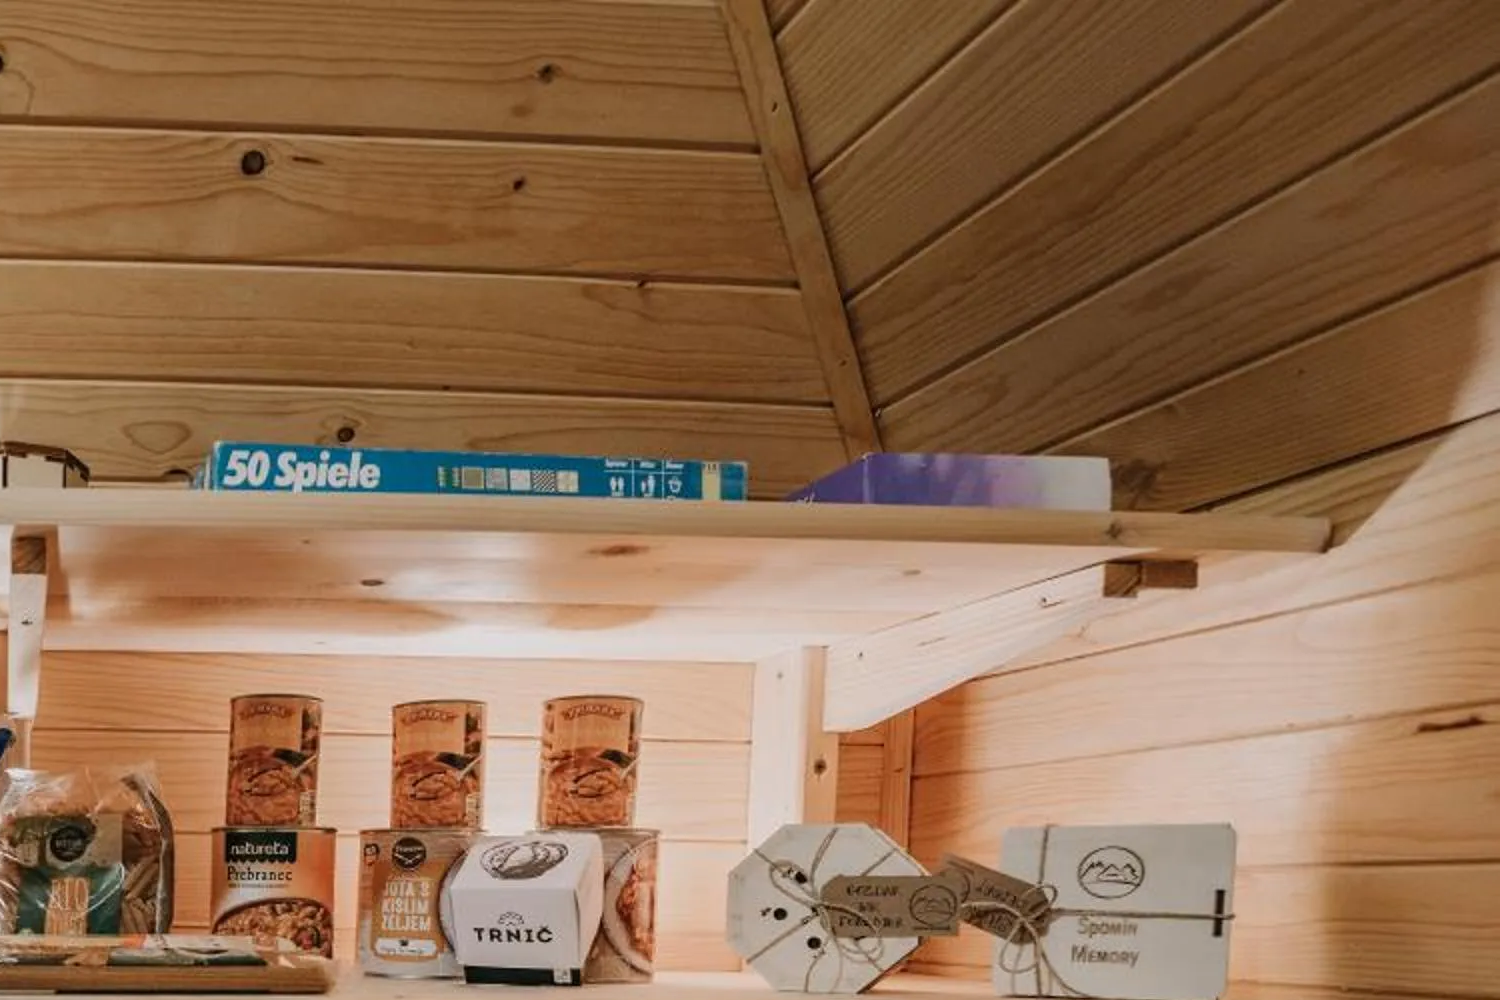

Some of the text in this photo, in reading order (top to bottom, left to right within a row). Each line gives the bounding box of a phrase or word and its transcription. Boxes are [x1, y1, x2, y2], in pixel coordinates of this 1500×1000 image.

[223, 450, 382, 492] 50 Spiele
[230, 841, 290, 855] natureta
[227, 866, 293, 881] Prebranec
[473, 926, 553, 943] TRNIČ
